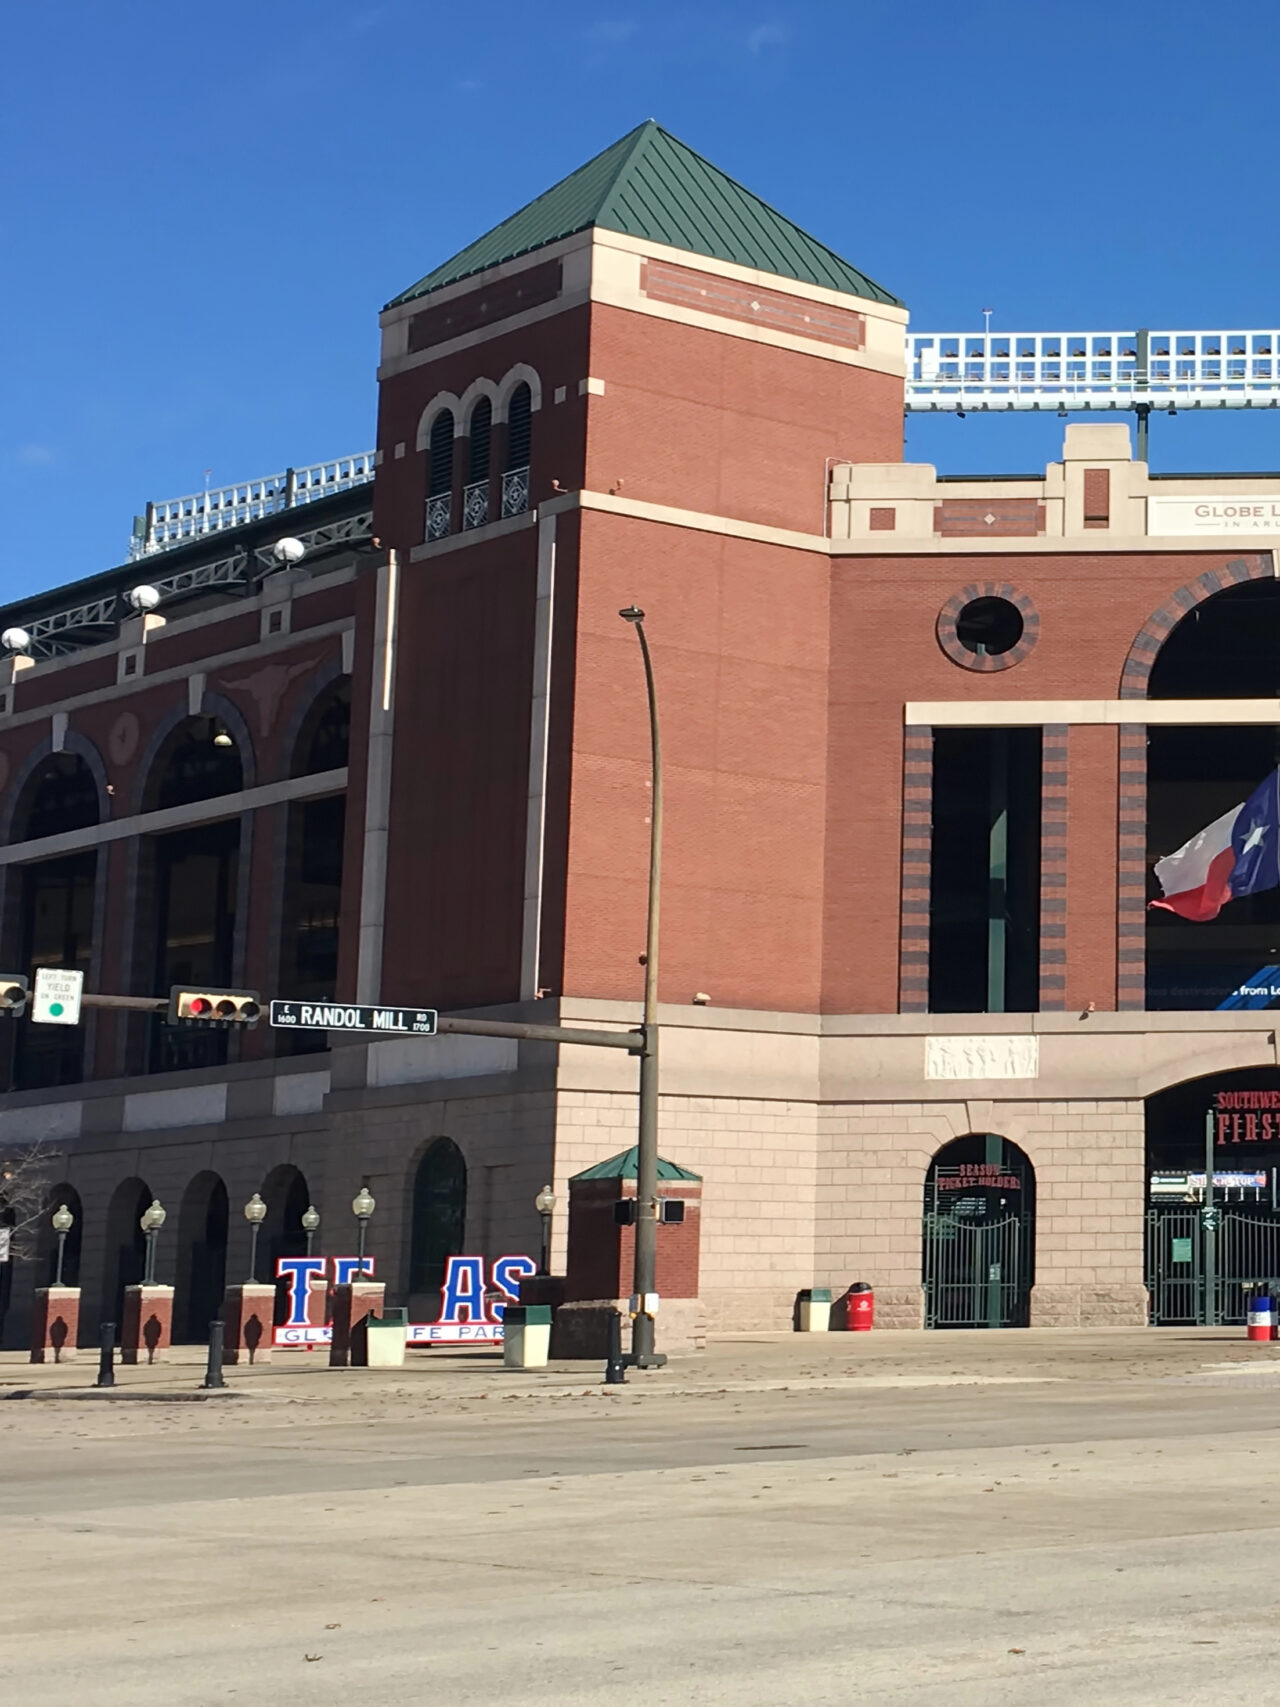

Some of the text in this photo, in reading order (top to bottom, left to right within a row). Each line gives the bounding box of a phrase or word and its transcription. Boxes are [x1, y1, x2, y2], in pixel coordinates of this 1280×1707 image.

[1195, 504, 1265, 518] GLOBE
[48, 983, 71, 992] YIELD
[1239, 985, 1268, 996] from
[283, 1004, 290, 1014] E
[277, 1014, 297, 1024] 1600
[300, 1005, 408, 1031] RANDOL MILL
[416, 1013, 428, 1022] RD
[412, 1022, 430, 1032] 1700
[959, 1164, 1000, 1176] SEASON
[937, 1177, 975, 1190] TICKET
[276, 1256, 538, 1325] TAS
[458, 1326, 506, 1339] PAR
